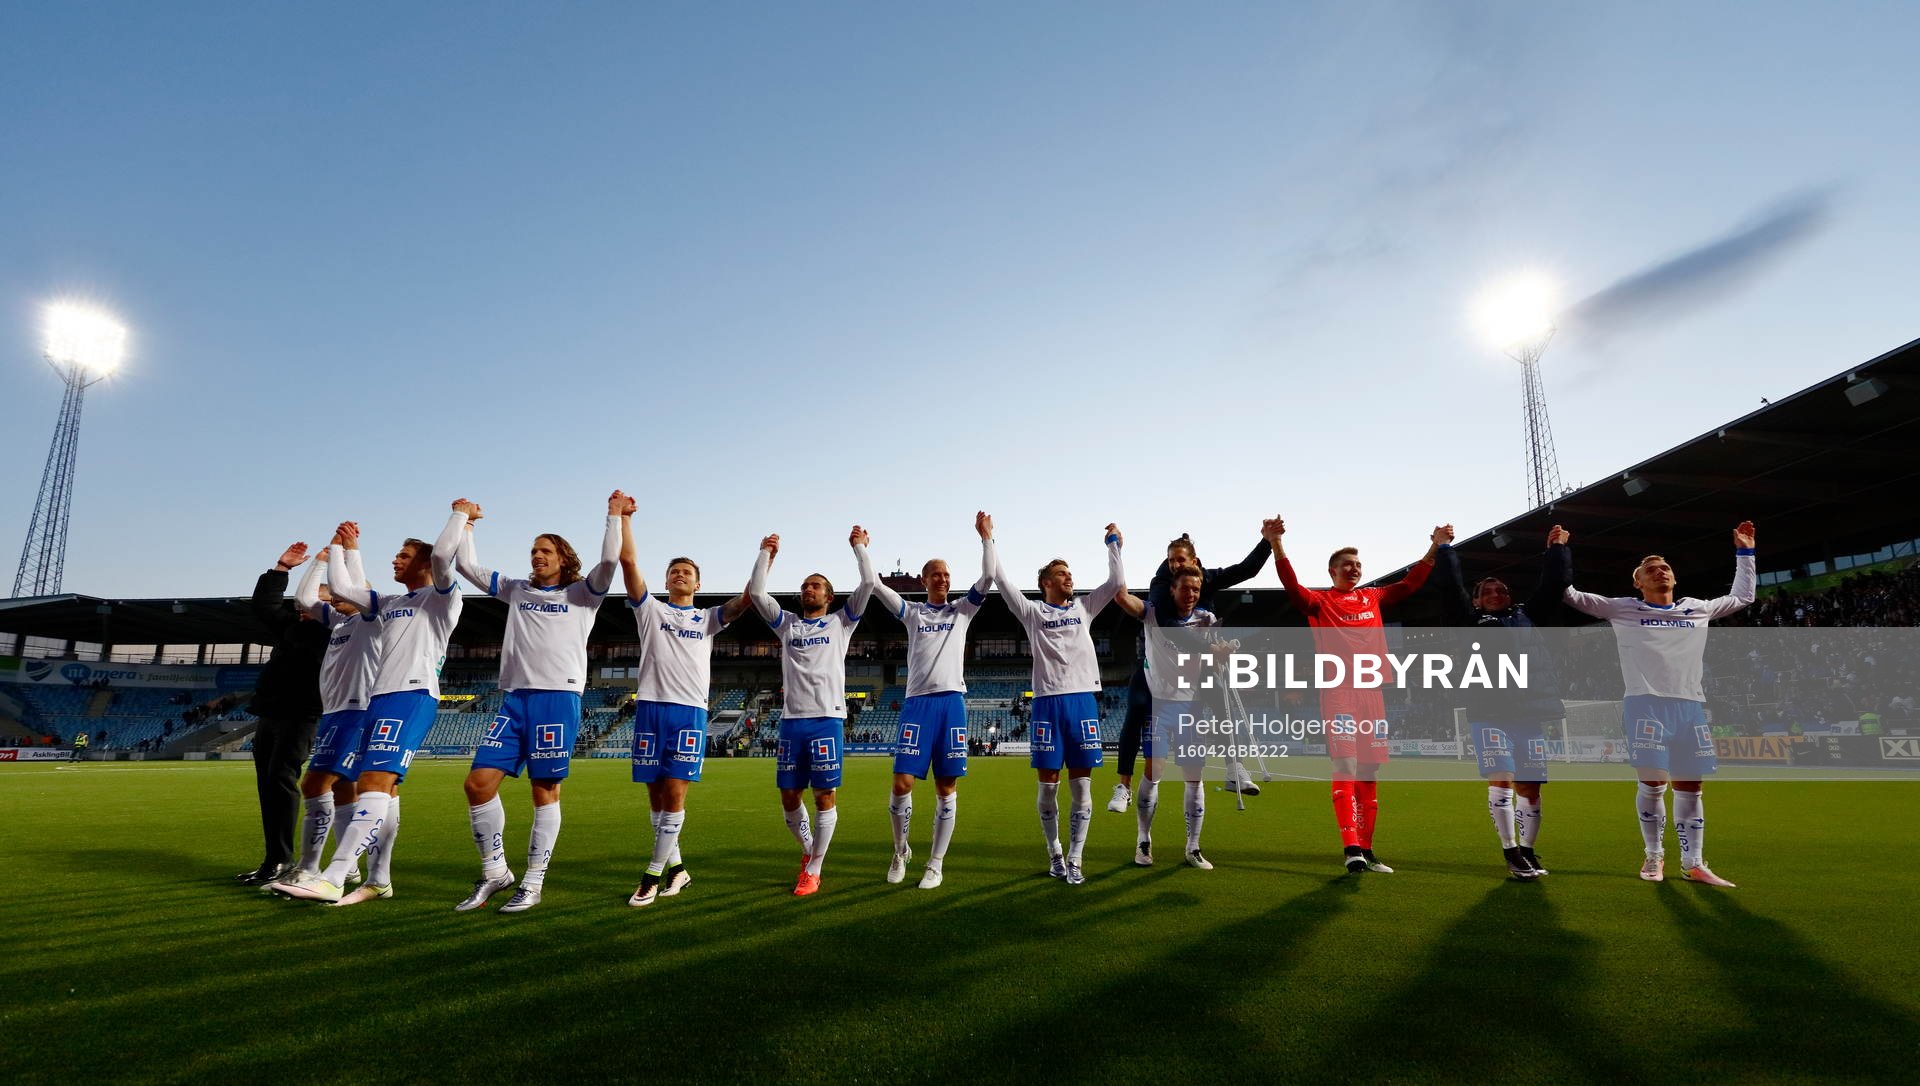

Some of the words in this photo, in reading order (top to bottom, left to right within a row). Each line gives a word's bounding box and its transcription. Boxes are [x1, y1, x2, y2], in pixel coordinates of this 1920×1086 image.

[519, 602, 568, 613] HOLMEN
[1042, 617, 1081, 629] HOLMEN
[1640, 619, 1695, 628] HOLMEN
[659, 622, 704, 640] HMEN
[92, 669, 137, 680] mera
[530, 750, 569, 760] stadium
[1483, 757, 1497, 768] 30
